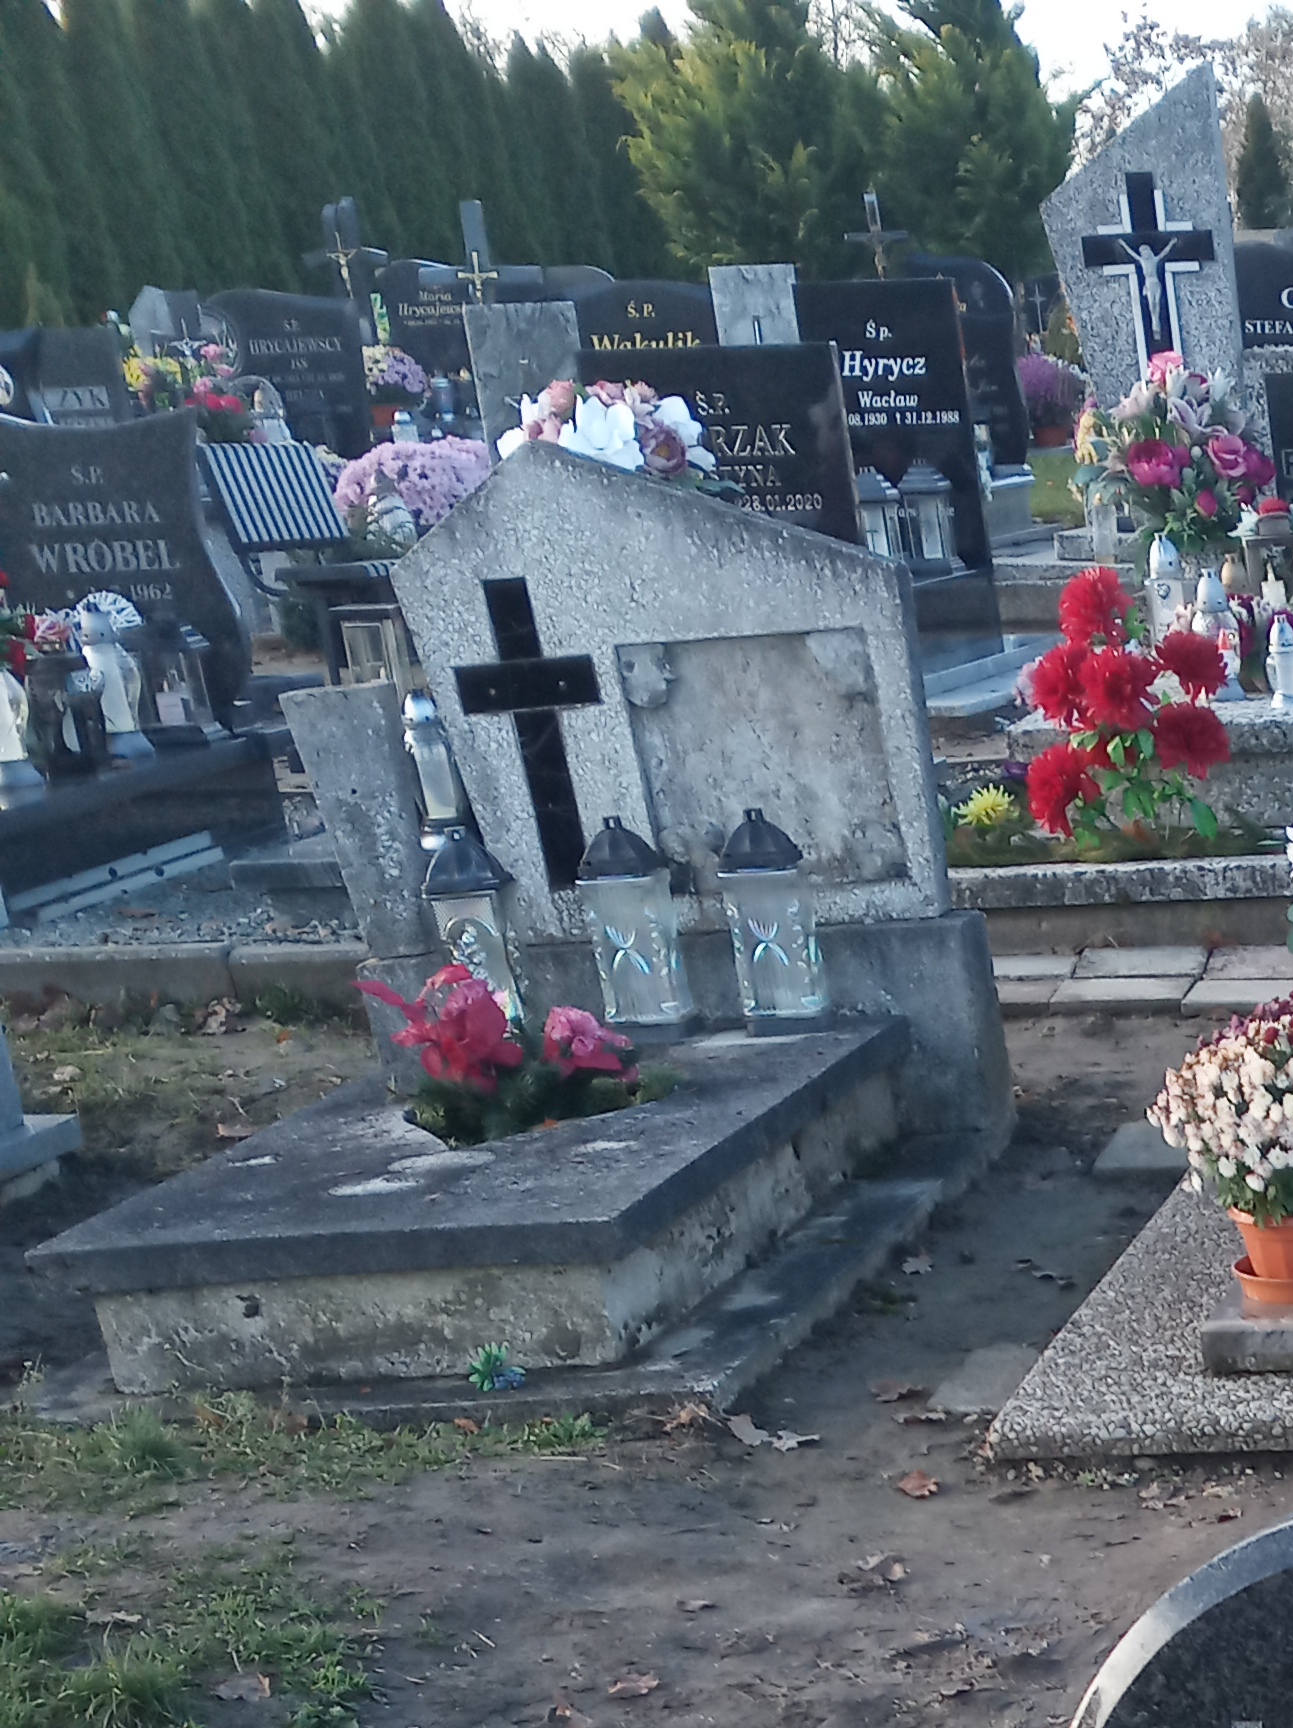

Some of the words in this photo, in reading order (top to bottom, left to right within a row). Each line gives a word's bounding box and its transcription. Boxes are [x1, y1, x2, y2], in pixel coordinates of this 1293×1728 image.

[841, 350, 927, 382] Hyrycz
[857, 390, 919, 409] Wacław
[847, 413, 888, 427] 08.1930
[708, 423, 796, 457] RZAK
[711, 464, 782, 487] TYNA
[31, 500, 161, 527] BARBARA
[28, 537, 181, 574] WRÓBEL
